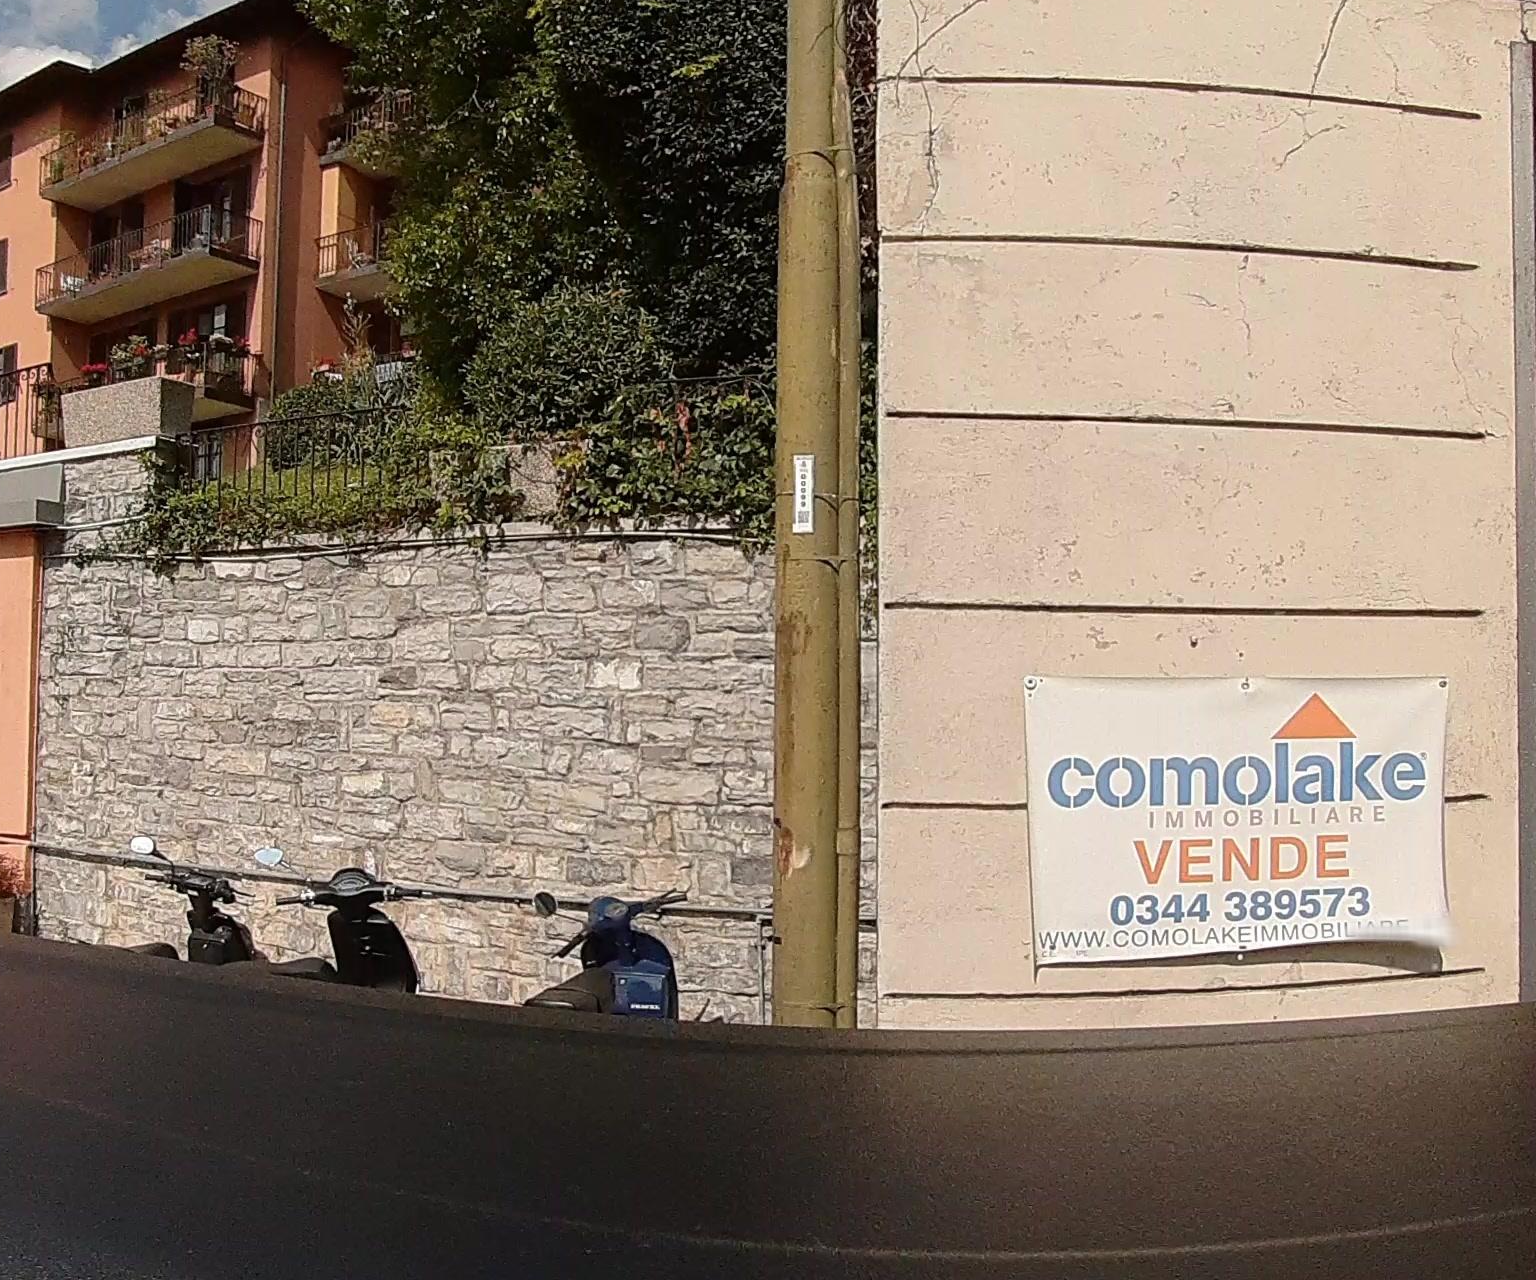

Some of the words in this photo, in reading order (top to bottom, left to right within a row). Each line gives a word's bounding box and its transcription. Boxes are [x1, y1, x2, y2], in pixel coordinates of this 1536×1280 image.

[1148, 805, 1386, 829] IMMOBILIARE
[1133, 834, 1350, 885] VENDE
[1110, 892, 1211, 926] 0344
[1223, 886, 1371, 923] 389573
